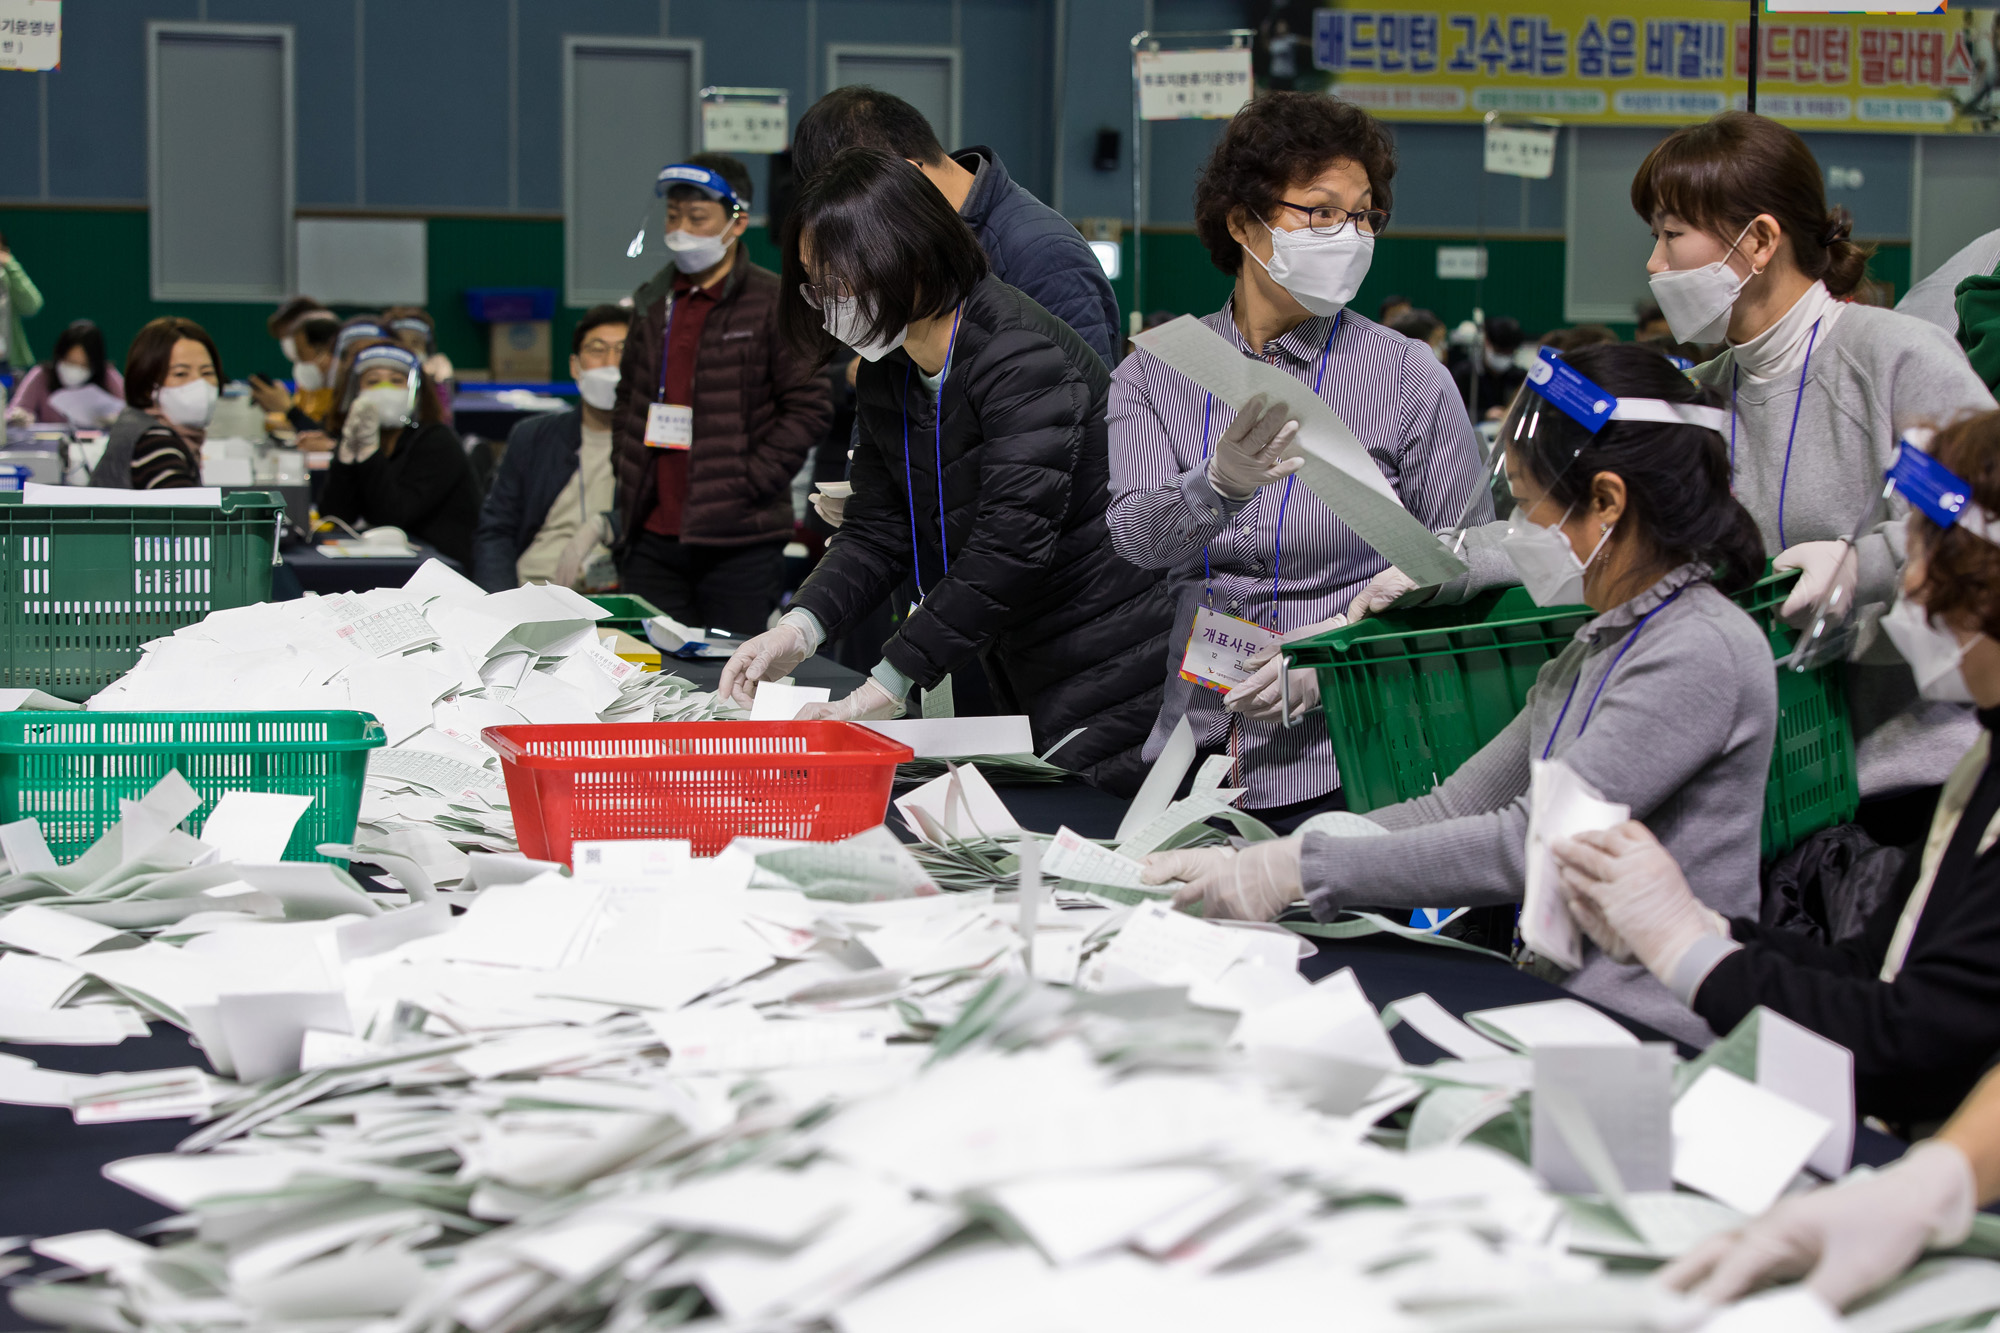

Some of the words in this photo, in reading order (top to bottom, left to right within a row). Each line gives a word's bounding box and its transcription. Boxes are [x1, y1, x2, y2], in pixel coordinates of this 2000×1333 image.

[1314, 10, 1438, 72] 배드민턴
[1449, 17, 1566, 75] 고수되는
[1577, 19, 1635, 77] 숨은
[1646, 21, 1725, 79] 비결!!
[1861, 29, 1972, 85] 필라테스
[1203, 628, 1264, 656] 개표사무
